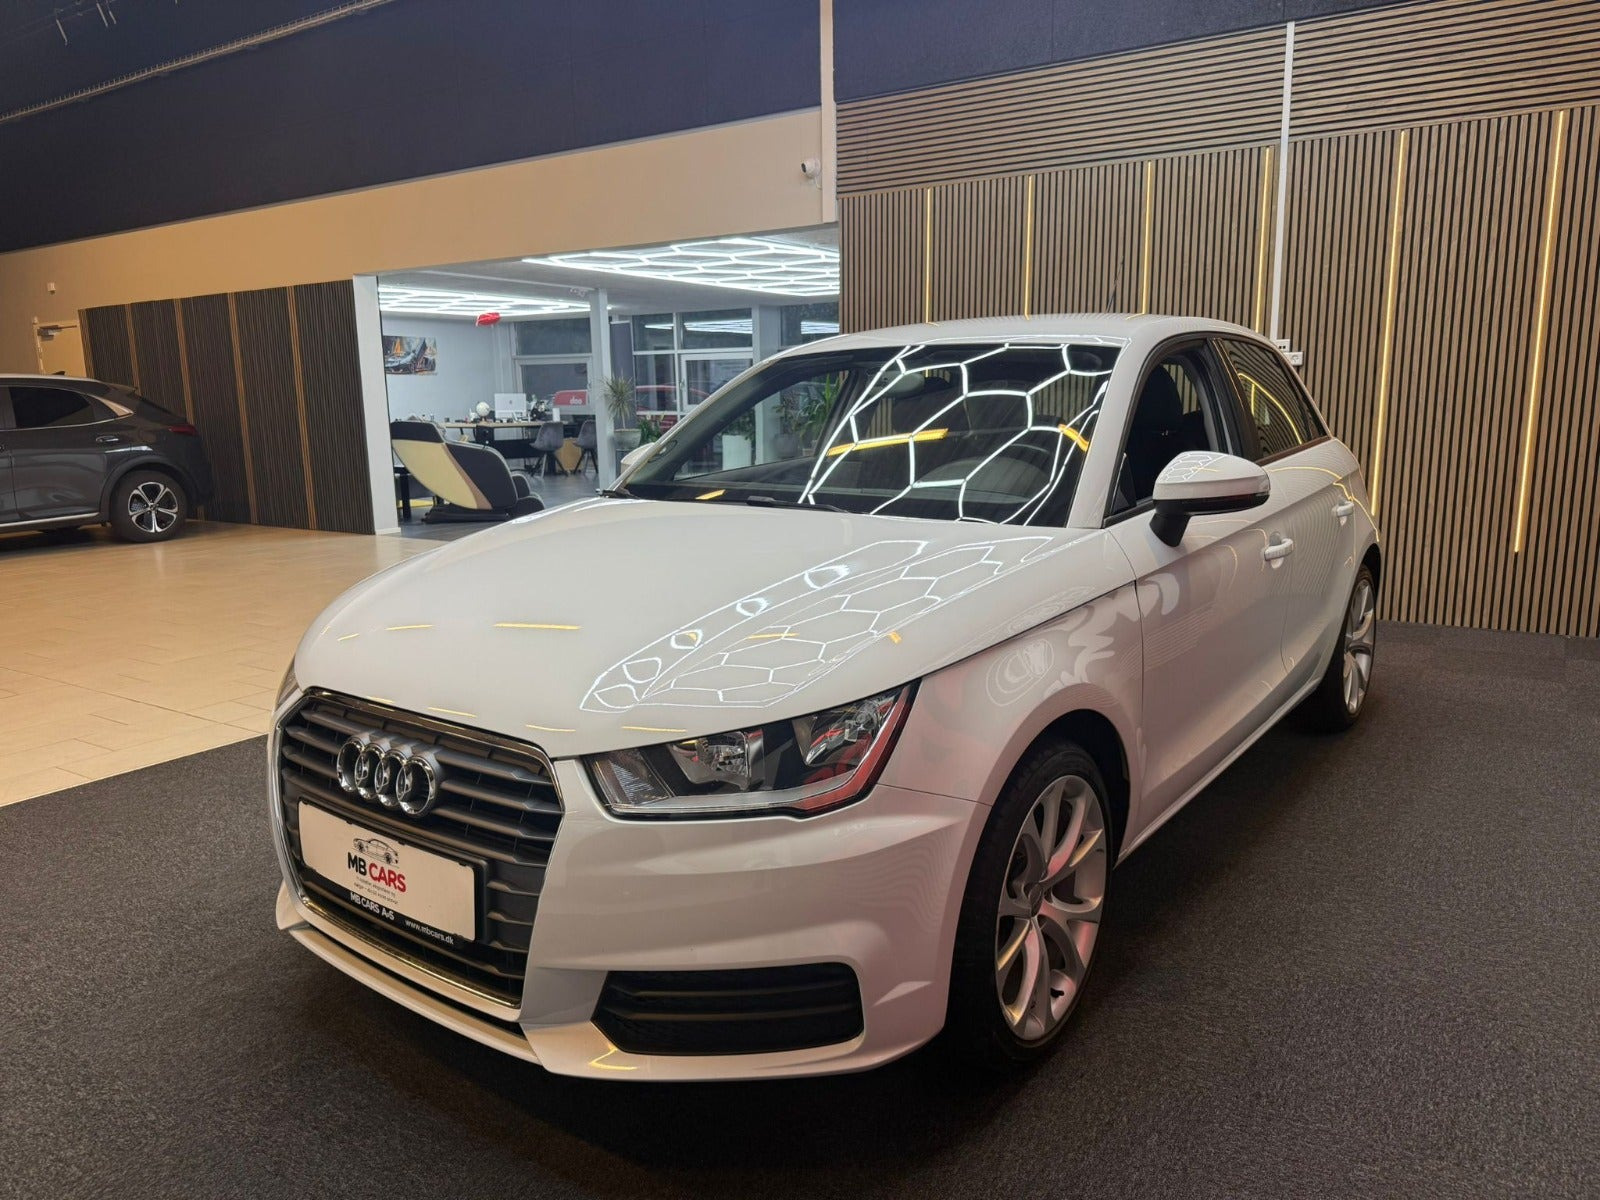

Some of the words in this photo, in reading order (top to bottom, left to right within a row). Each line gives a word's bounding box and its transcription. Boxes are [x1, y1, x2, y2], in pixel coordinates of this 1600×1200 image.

[347, 852, 367, 876] MB
[368, 863, 407, 893] CARS
[350, 891, 361, 905] MB
[361, 898, 380, 914] CARS
[404, 919, 454, 945] www.mbcars.dk
